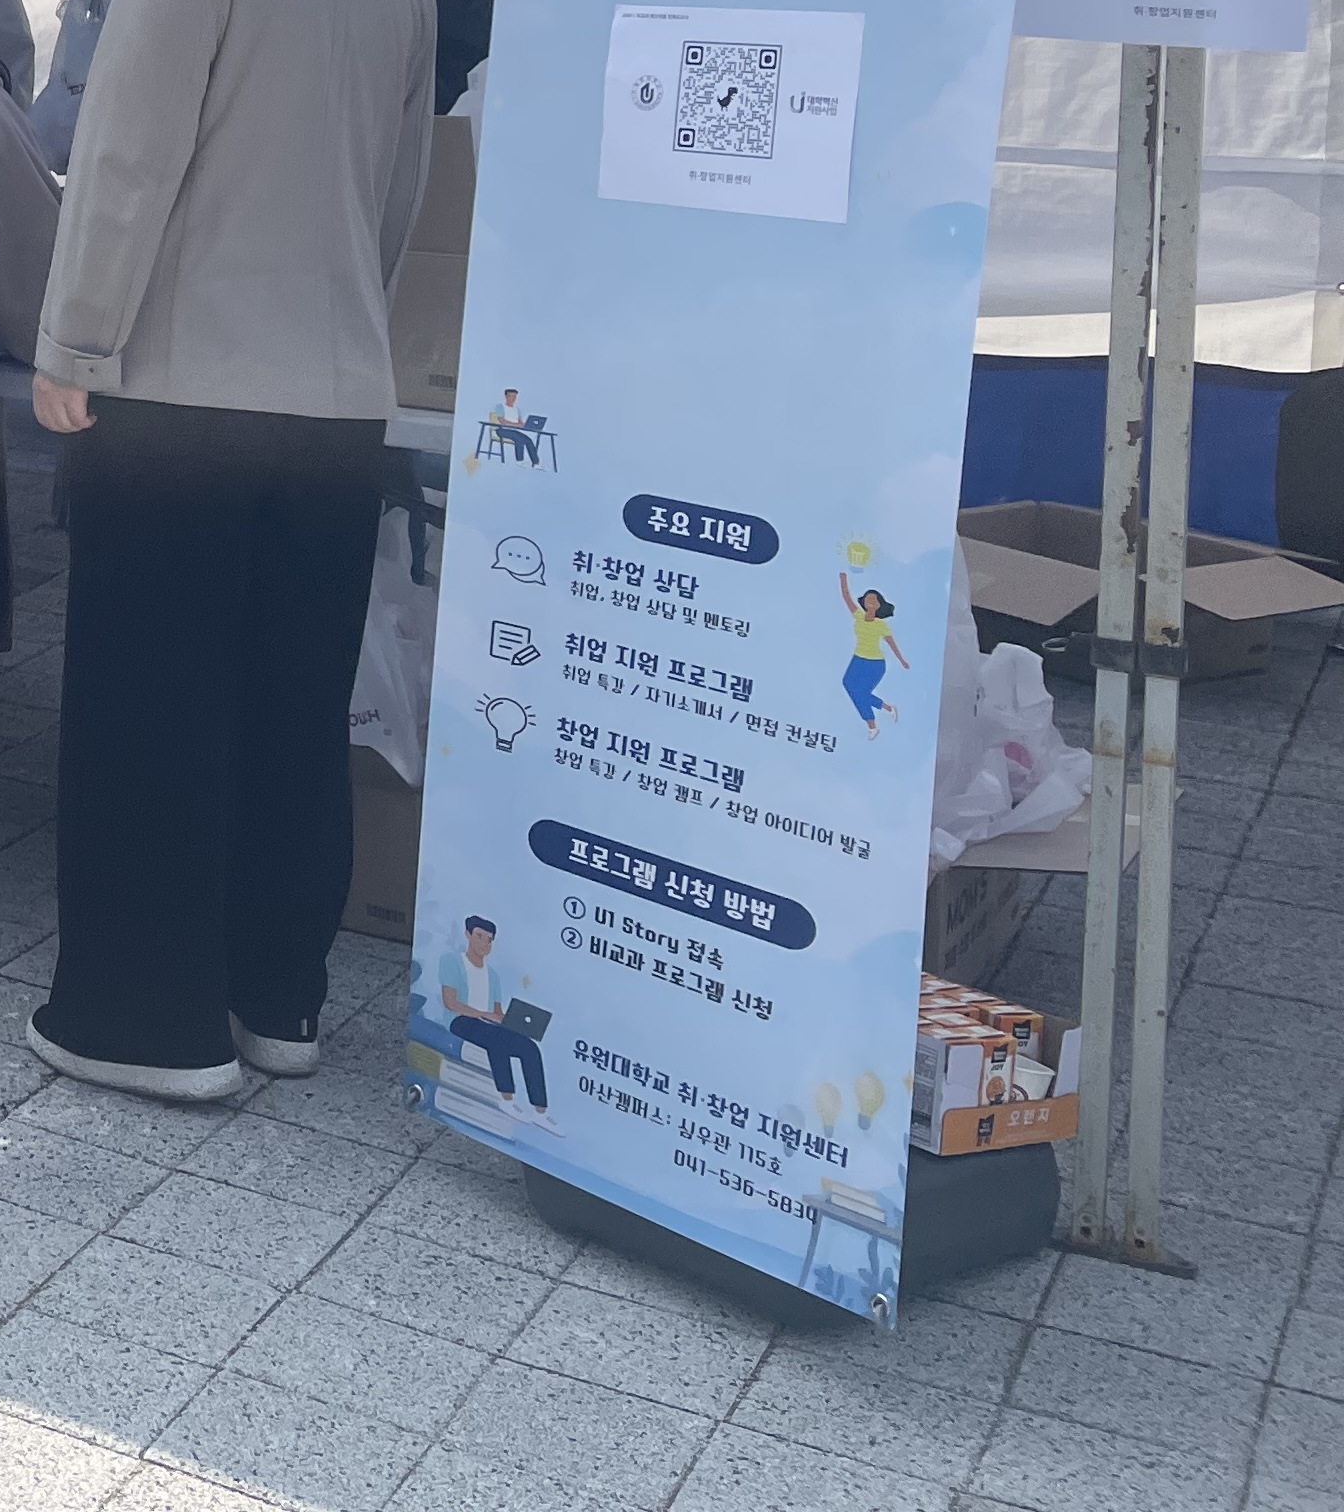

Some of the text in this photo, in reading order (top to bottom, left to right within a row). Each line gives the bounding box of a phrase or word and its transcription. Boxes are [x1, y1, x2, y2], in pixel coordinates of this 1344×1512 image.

[648, 506, 751, 551] 주요 지원
[570, 580, 750, 638] 취업, 창업 상담 및 멘토링
[573, 550, 700, 600] 취·창업 상담
[565, 633, 753, 703] 취업 지원 프로그램
[562, 664, 591, 686] 취업
[597, 673, 624, 694] 특강
[645, 686, 723, 720] 자기소개서
[746, 713, 779, 737] 면접
[785, 724, 837, 753] 컨설팅
[556, 717, 745, 793] 창업 지원 프로그램
[554, 748, 583, 770] 창업
[589, 758, 616, 779] 특강
[637, 773, 668, 796] 창업
[674, 783, 702, 806] 캠프
[726, 800, 758, 825] 창업
[765, 812, 834, 846] 아이디어
[840, 834, 871, 859] 발굴
[569, 838, 776, 931] 프로그램 신청 방법
[594, 906, 615, 928] U1
[622, 916, 679, 954] Story
[687, 938, 724, 970] 접속
[590, 936, 645, 971] 비교과
[652, 958, 725, 1004] 프로그램
[732, 989, 773, 1021] 신청
[573, 1040, 848, 1168] 유원대학교 취·창업 지원센터
[579, 1076, 671, 1126] 아산캠퍼스:
[739, 1142, 782, 1176] 115호
[674, 1149, 817, 1225] 041-536-5834
